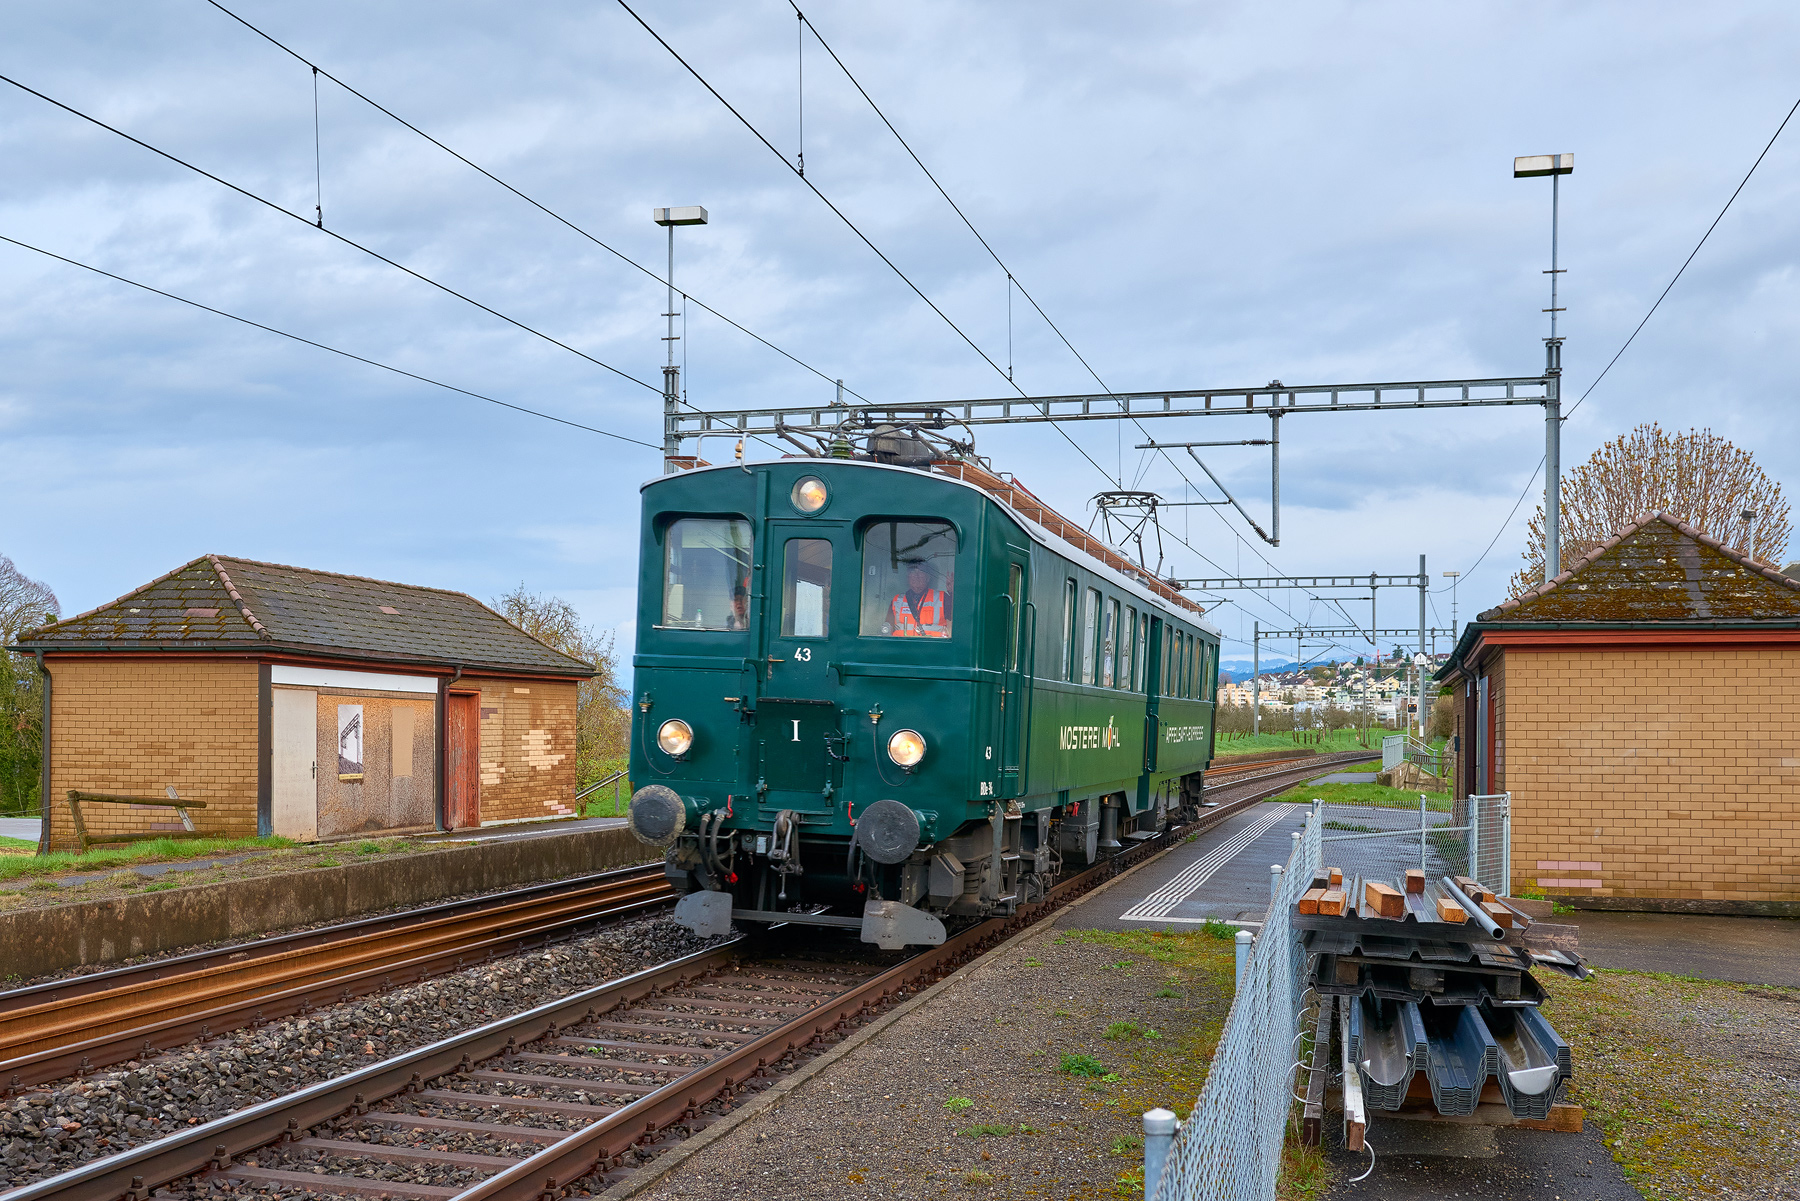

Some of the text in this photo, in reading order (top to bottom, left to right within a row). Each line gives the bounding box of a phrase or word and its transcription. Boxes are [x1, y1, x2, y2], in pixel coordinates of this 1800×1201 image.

[794, 647, 812, 662] 43
[1059, 725, 1101, 750] MOSTEREI
[985, 746, 992, 760] 43
